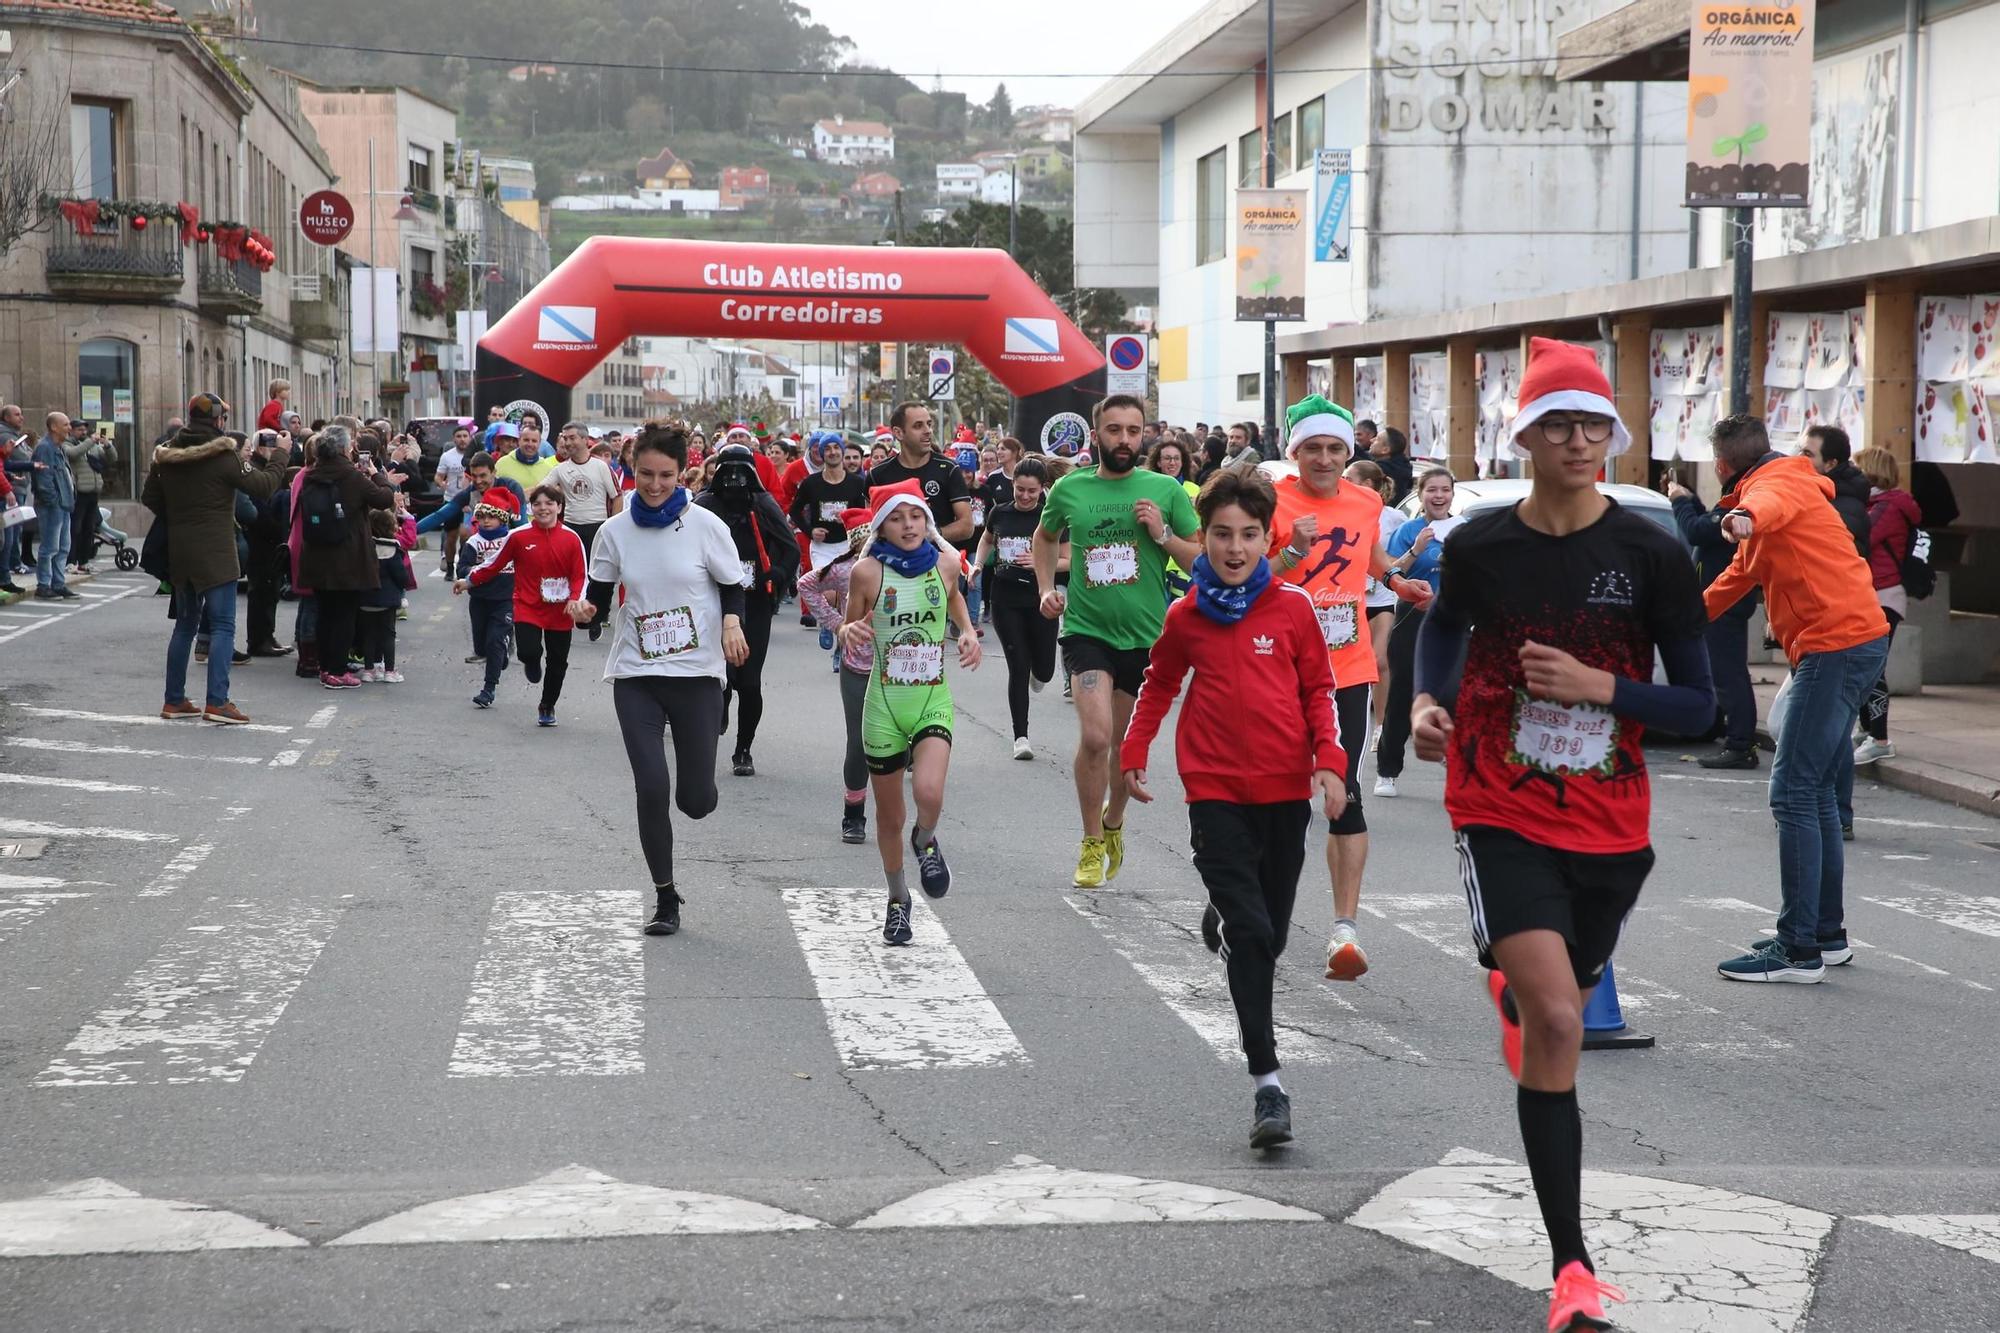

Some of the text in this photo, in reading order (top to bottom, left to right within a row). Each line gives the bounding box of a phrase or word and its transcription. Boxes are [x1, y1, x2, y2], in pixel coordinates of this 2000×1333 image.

[1706, 8, 1796, 25] ORGÁNICA
[1702, 27, 1805, 46] Ao marrón!
[1388, 40, 1558, 78] SOCI
[1388, 91, 1616, 132] DO MAR
[1319, 168, 1349, 176] do Mar
[1320, 160, 1348, 168] Social
[1245, 208, 1296, 219] ORGÁNICA
[306, 216, 348, 228] MUSEO
[703, 263, 902, 291] Club Atletismo
[721, 299, 883, 324] Corredoiras
[1088, 529, 1134, 538] CALVARIO
[890, 611, 936, 627] IRIA
[655, 630, 676, 646] 111
[1539, 733, 1583, 756] 139
